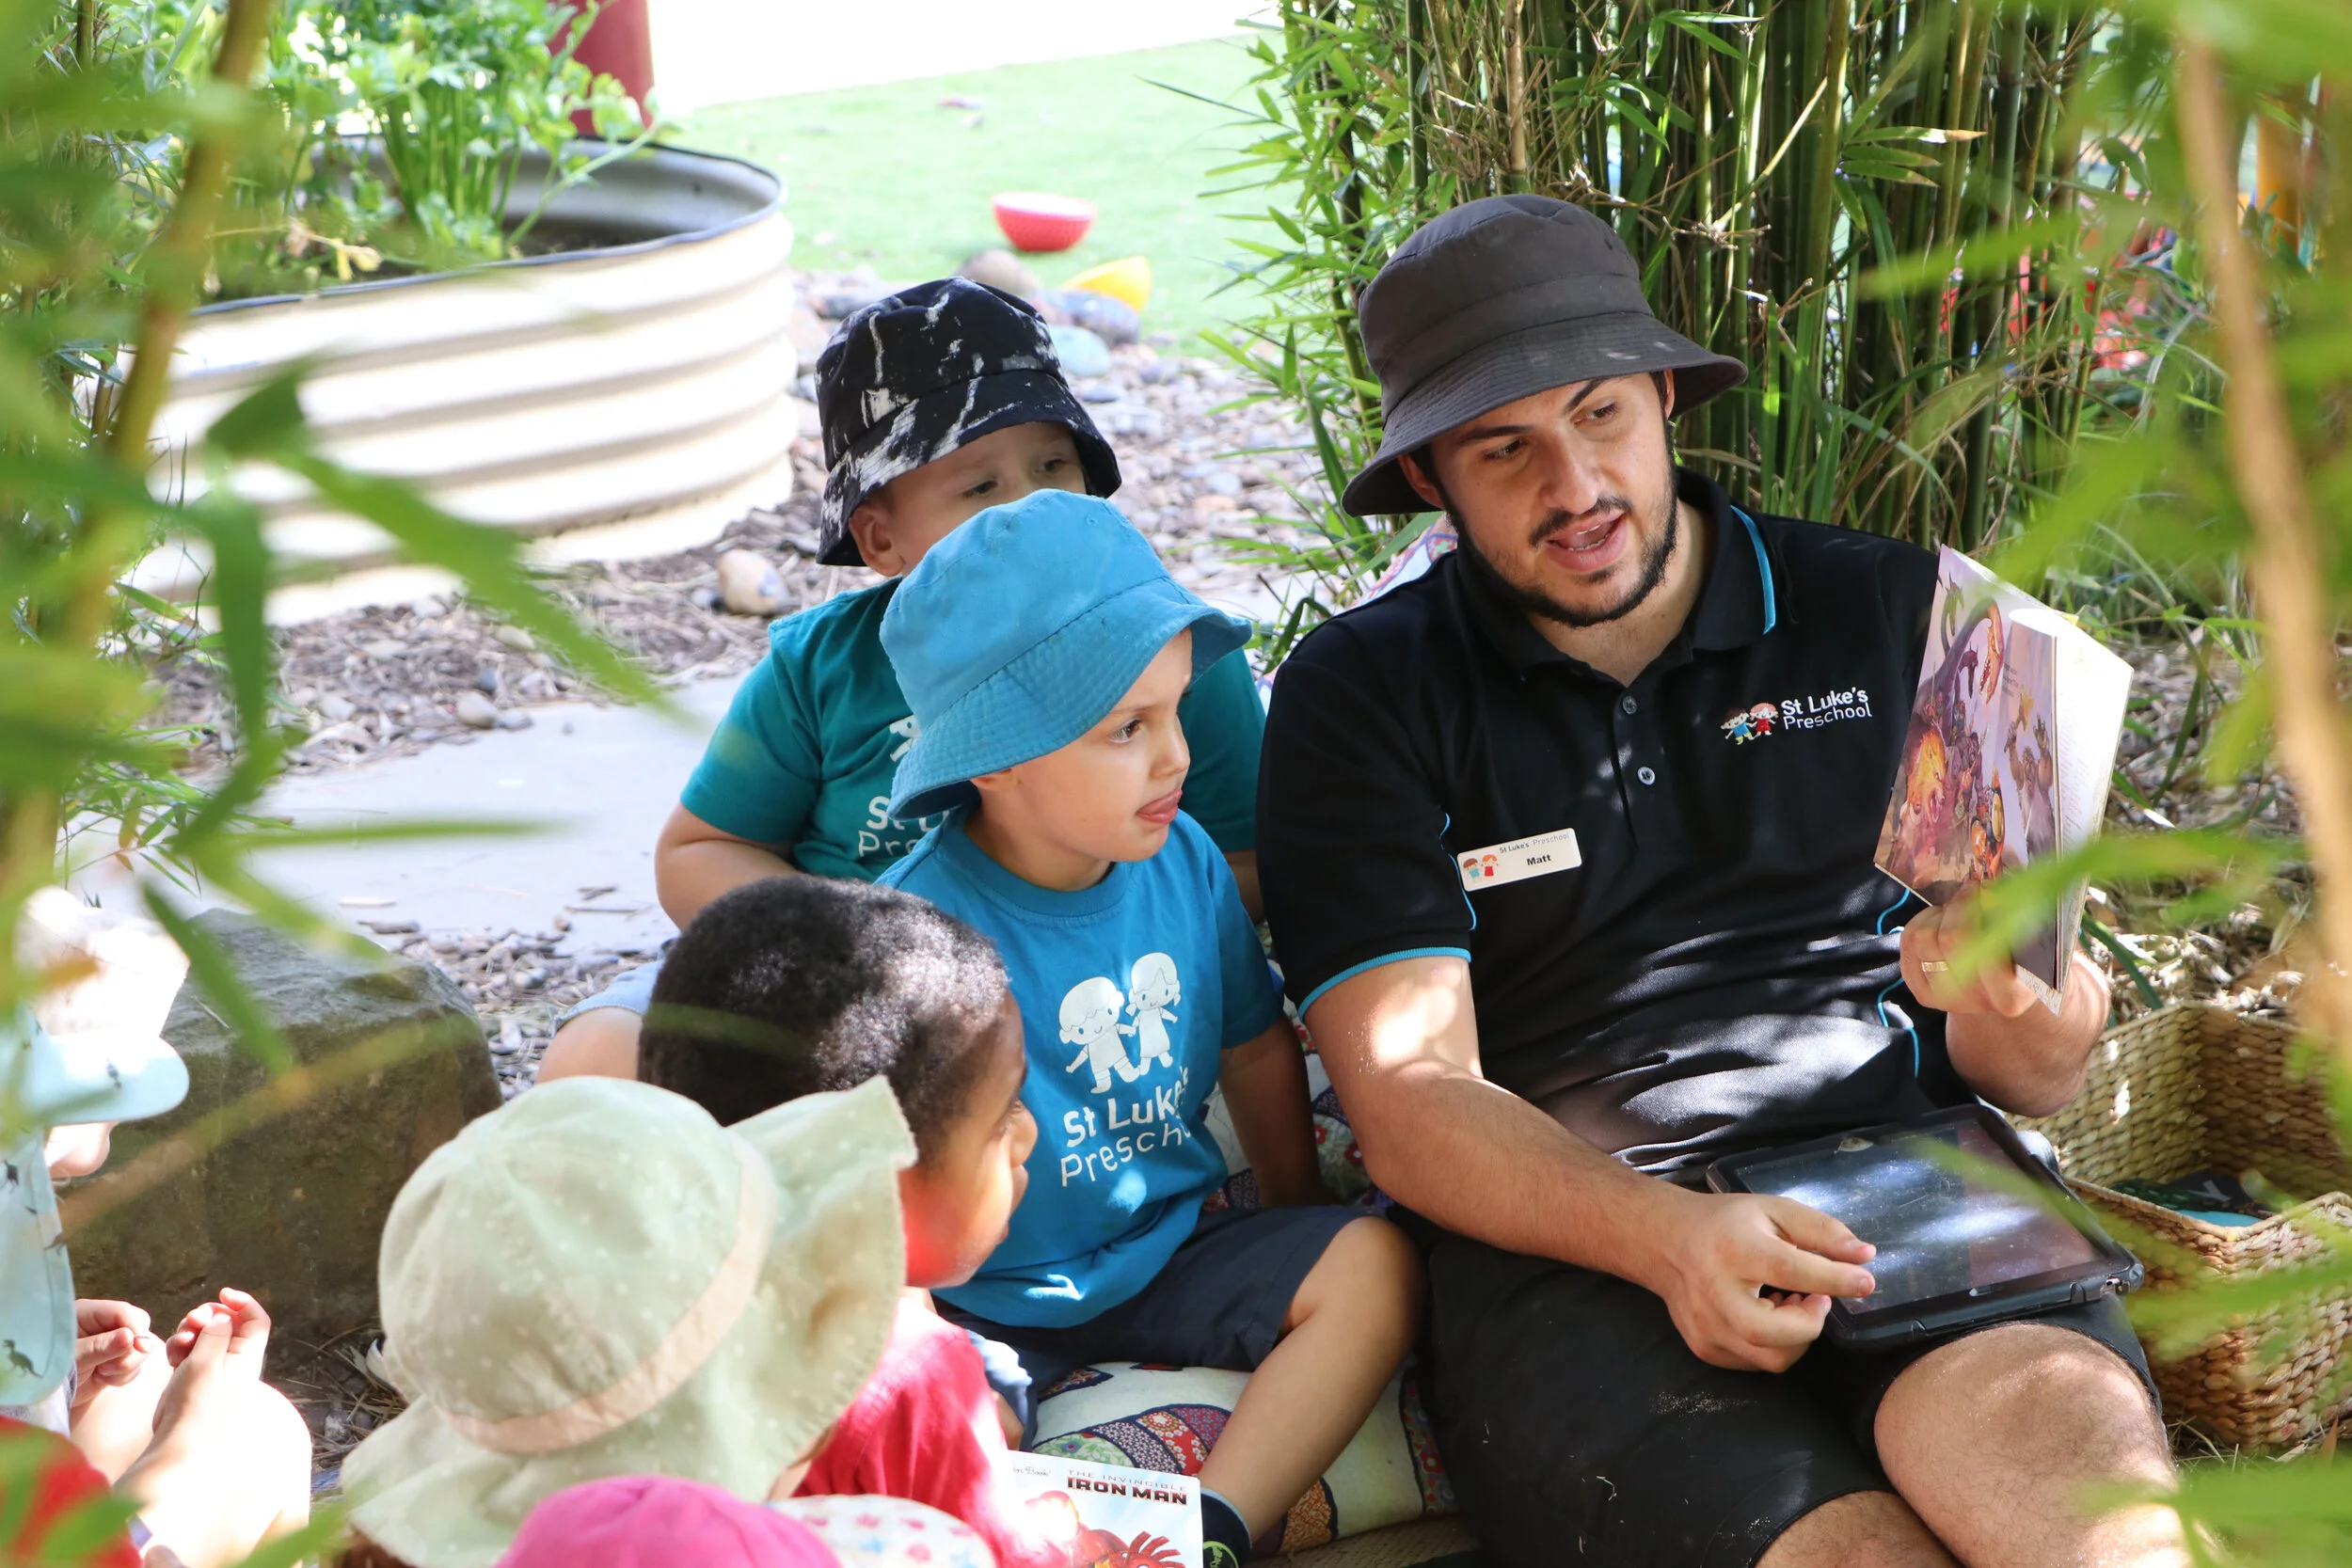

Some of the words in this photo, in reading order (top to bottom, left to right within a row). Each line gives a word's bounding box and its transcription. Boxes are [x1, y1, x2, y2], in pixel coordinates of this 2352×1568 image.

[1781, 699, 1804, 716] St
[1807, 687, 1868, 713] Luke's
[1783, 703, 1872, 730] Preschool
[1508, 842, 1530, 851] Luke's
[1533, 832, 1569, 846] Preschool
[1526, 854, 1551, 866] Matt
[1063, 1106, 1097, 1148] St
[1067, 1469, 1095, 1479] THE
[1103, 1474, 1188, 1493] INVINCIBLE
[1067, 1477, 1126, 1497] IRON
[1132, 1486, 1187, 1505] MAN
